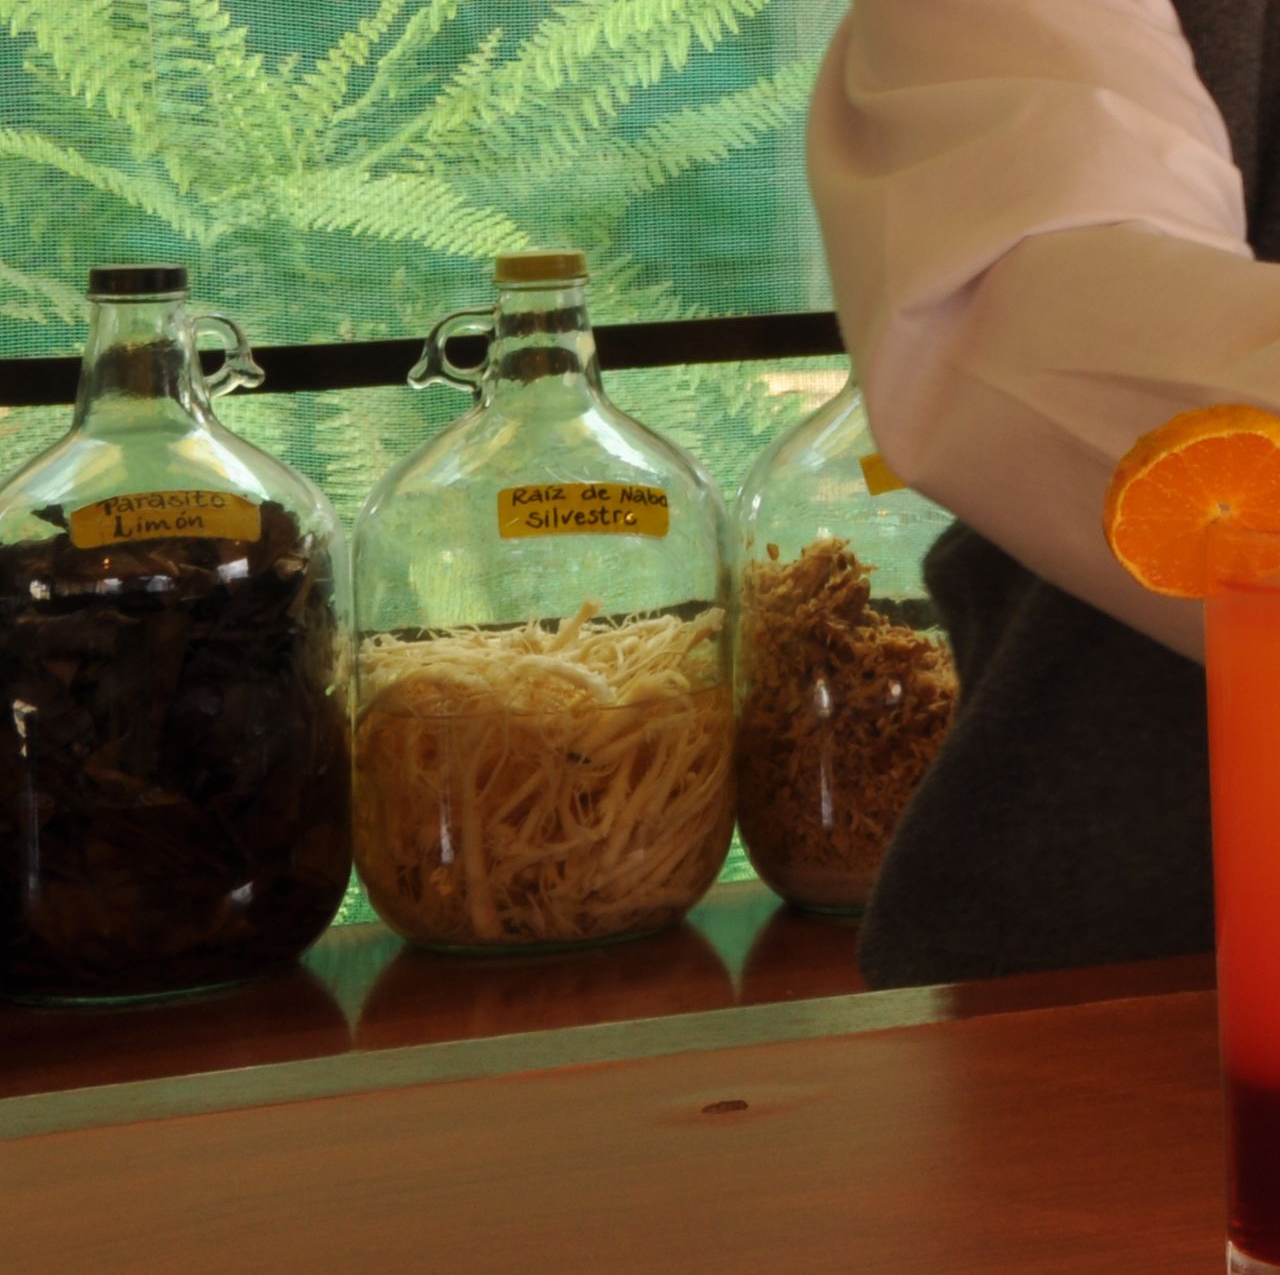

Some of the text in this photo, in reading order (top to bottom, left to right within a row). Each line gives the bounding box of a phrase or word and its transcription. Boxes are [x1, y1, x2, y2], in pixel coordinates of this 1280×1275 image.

[511, 484, 669, 508] Raíz de Nabo
[113, 511, 205, 539] Limón
